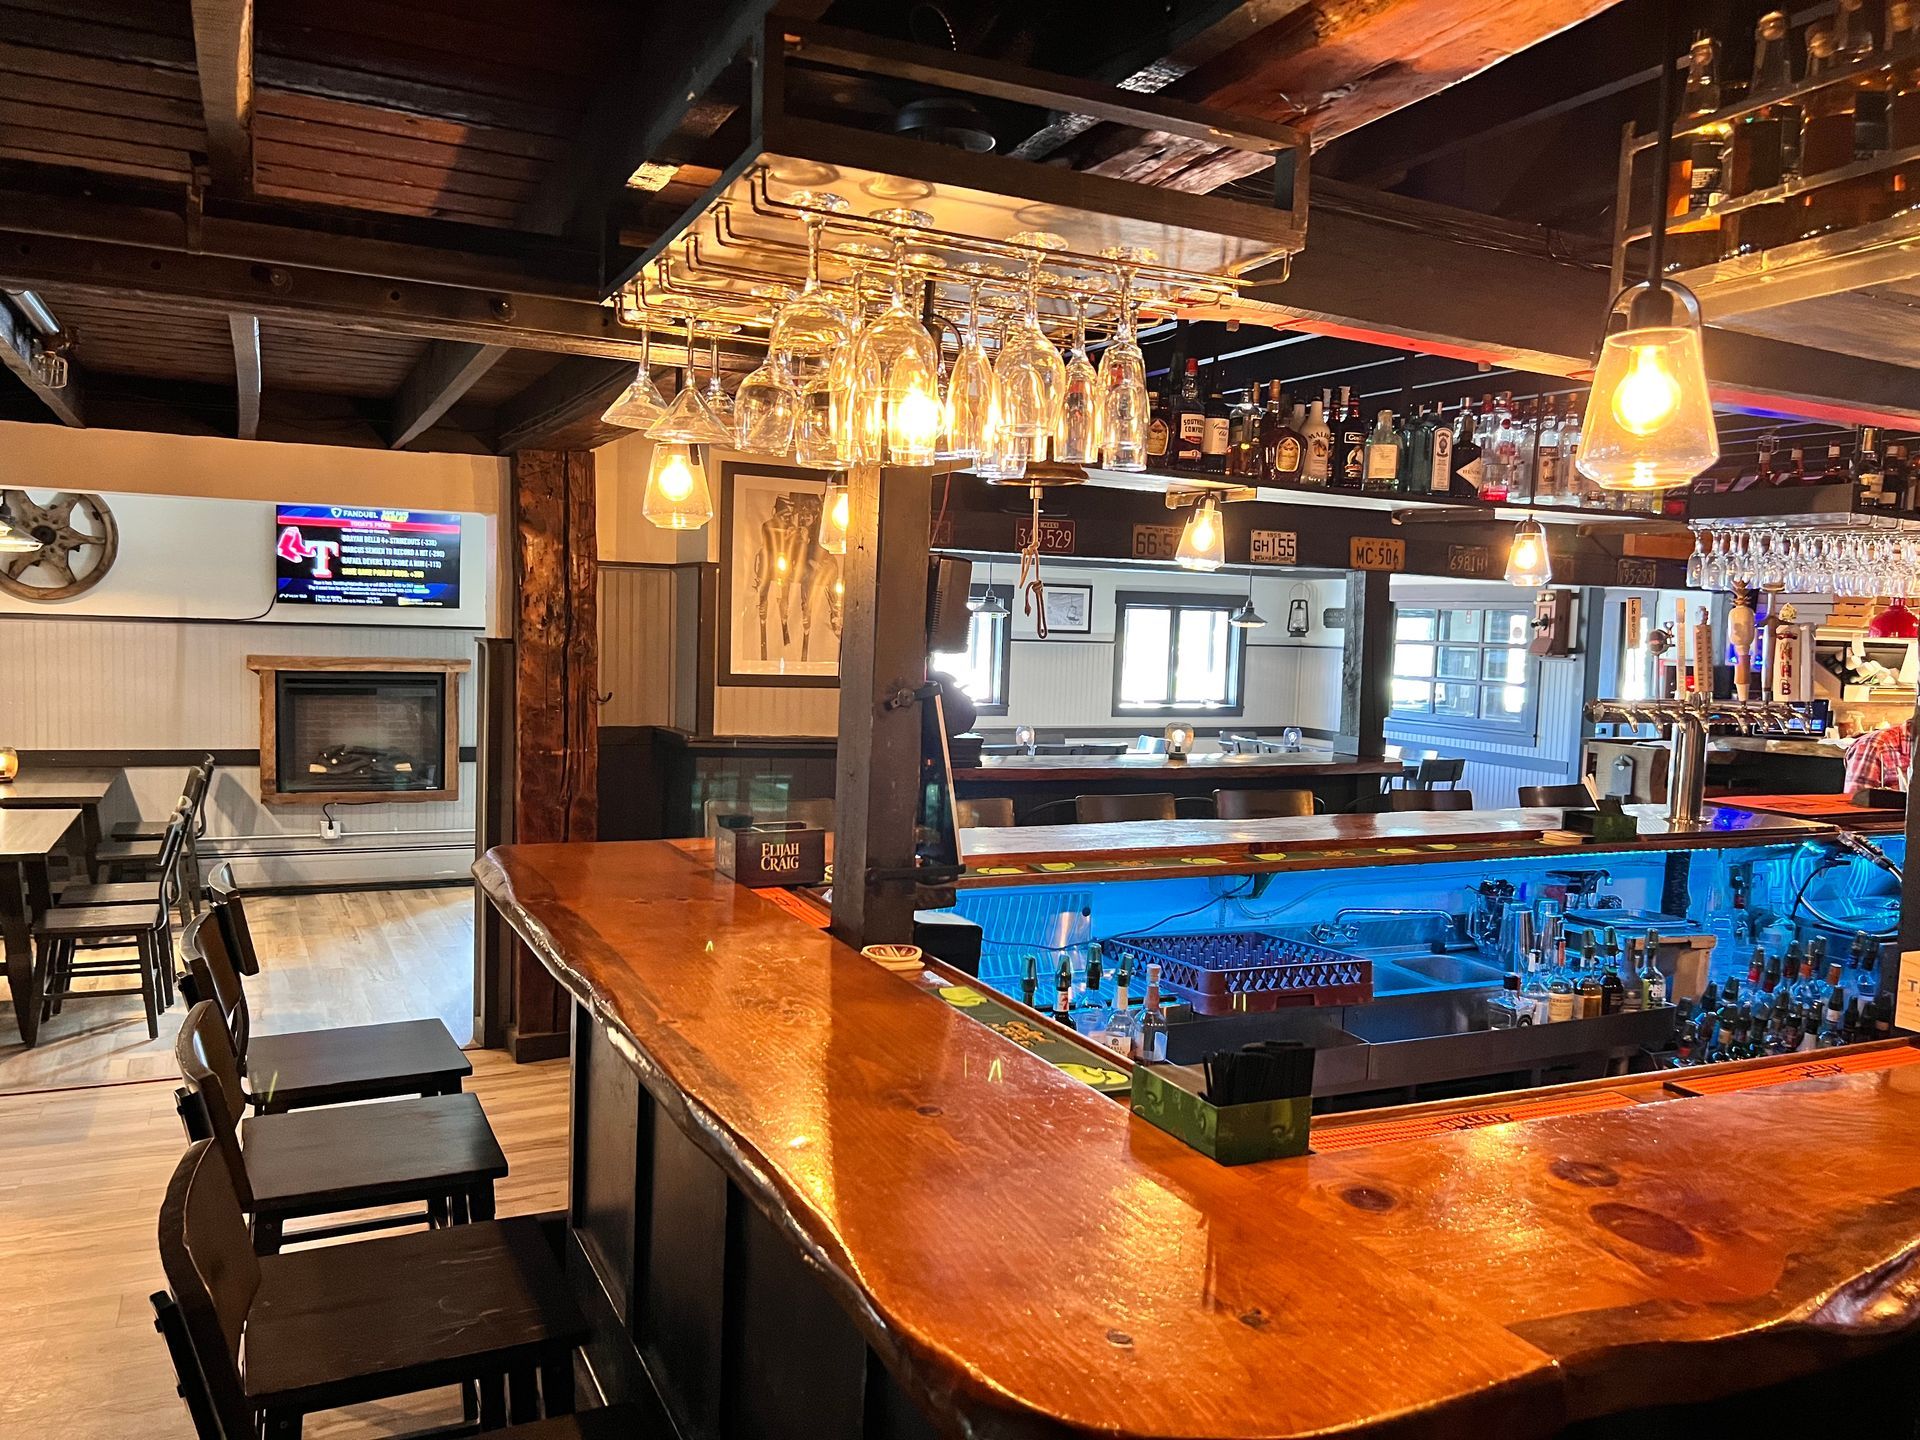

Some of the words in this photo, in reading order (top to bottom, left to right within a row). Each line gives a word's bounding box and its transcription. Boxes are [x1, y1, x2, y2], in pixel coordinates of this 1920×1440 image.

[343, 510, 379, 519] FANDUEL
[761, 842, 800, 858] ELIJAH
[760, 856, 800, 872] CRAIG
